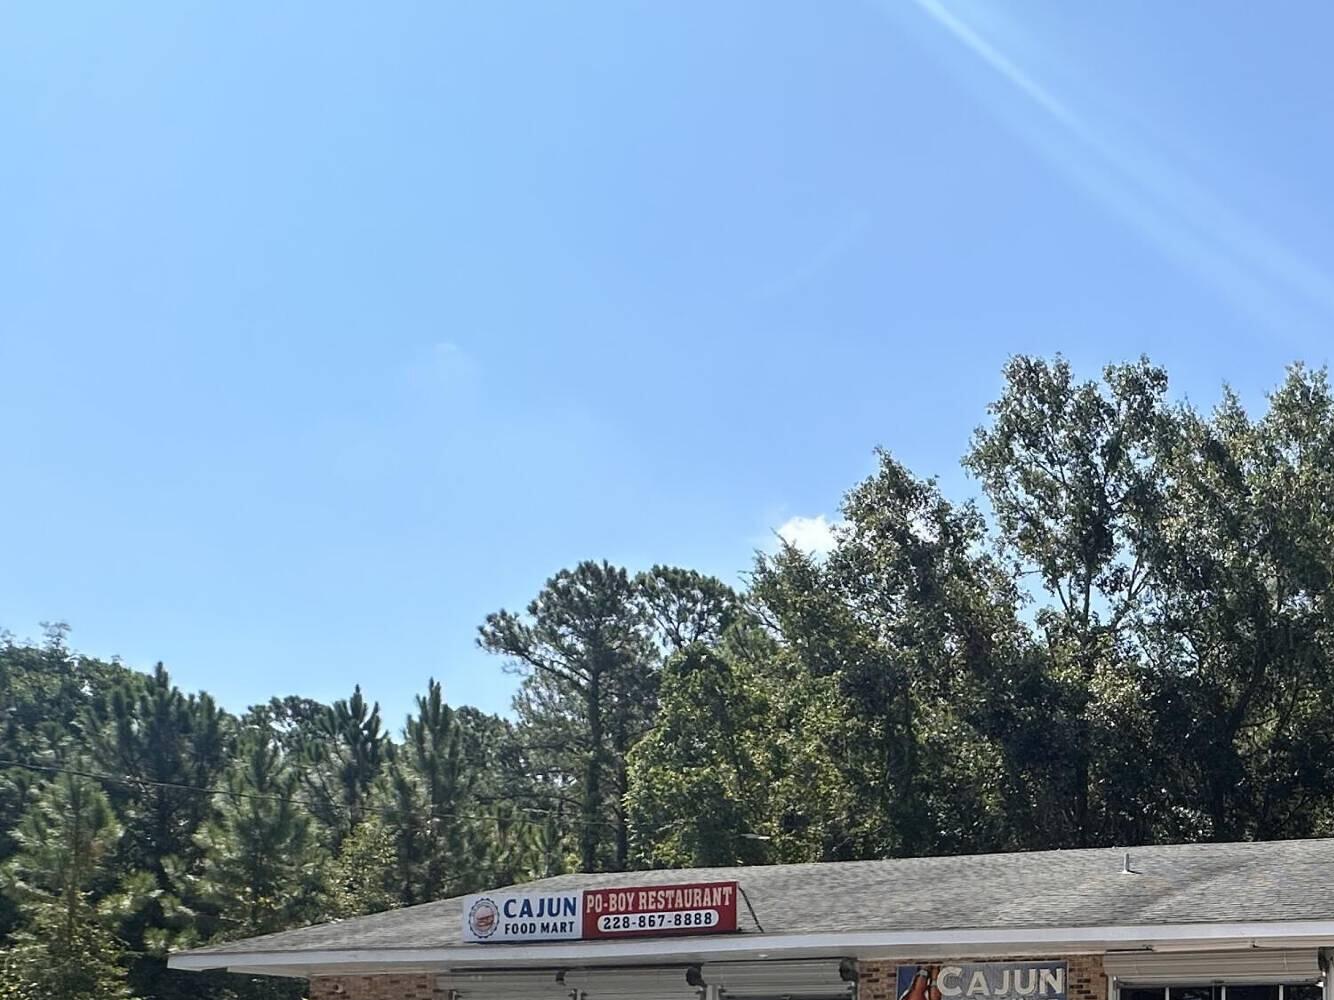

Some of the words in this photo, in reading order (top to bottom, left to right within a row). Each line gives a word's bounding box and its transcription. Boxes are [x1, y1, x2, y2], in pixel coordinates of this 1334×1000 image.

[503, 897, 577, 918] CAJUN
[586, 892, 635, 913] PO-BOY
[638, 886, 733, 910] RESTAURANT
[504, 923, 536, 935] FOOD
[540, 921, 575, 934] MART
[603, 912, 712, 930] 228-867-8888
[937, 966, 1064, 996] CAJUN
